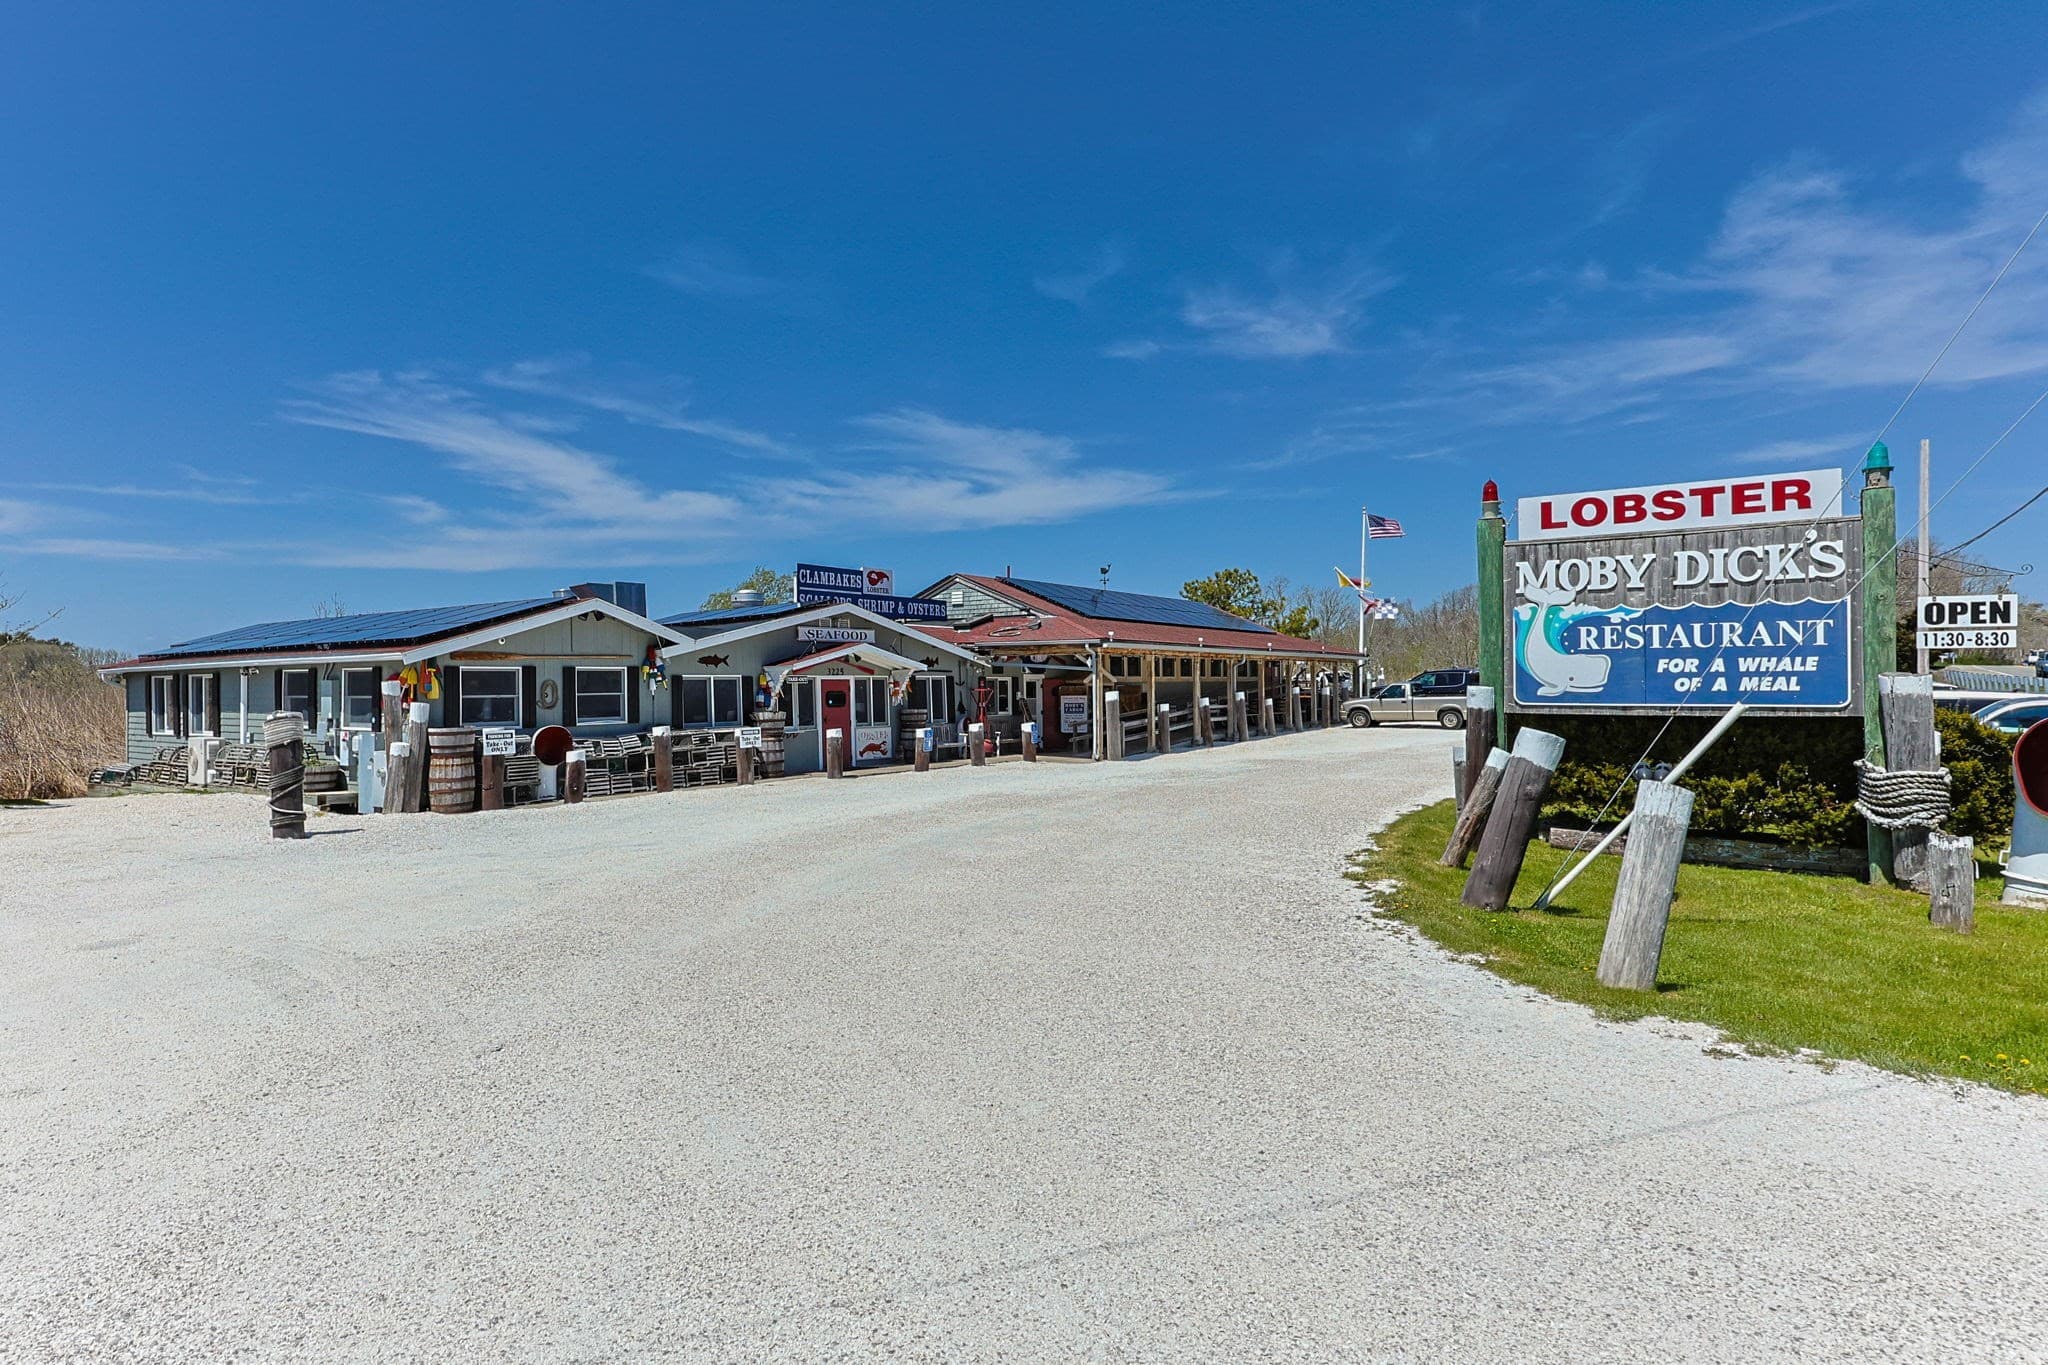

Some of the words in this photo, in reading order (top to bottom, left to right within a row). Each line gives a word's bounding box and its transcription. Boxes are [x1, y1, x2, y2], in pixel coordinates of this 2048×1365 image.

[1540, 478, 1812, 530] LOBSTER
[1515, 553, 1656, 595] MOBY
[1673, 529, 1847, 587] DICK'S
[799, 569, 862, 589] CLAMBAKES
[866, 586, 890, 594] LOBSTER
[857, 599, 895, 614] SHRIMP
[897, 602, 905, 614] &
[907, 602, 946, 617] OYSTERS
[1924, 600, 2011, 625] OPEN
[807, 629, 868, 641] SEAFOOD
[1577, 618, 1834, 651] RESTAURANT
[1923, 631, 2009, 647] 11:30-8:30
[1657, 657, 1706, 674] FOR
[1710, 657, 1726, 672] A
[1738, 656, 1819, 672] WHALE
[1674, 676, 1701, 692] OF
[1712, 676, 1727, 692] A
[1740, 675, 1801, 692] MEAL
